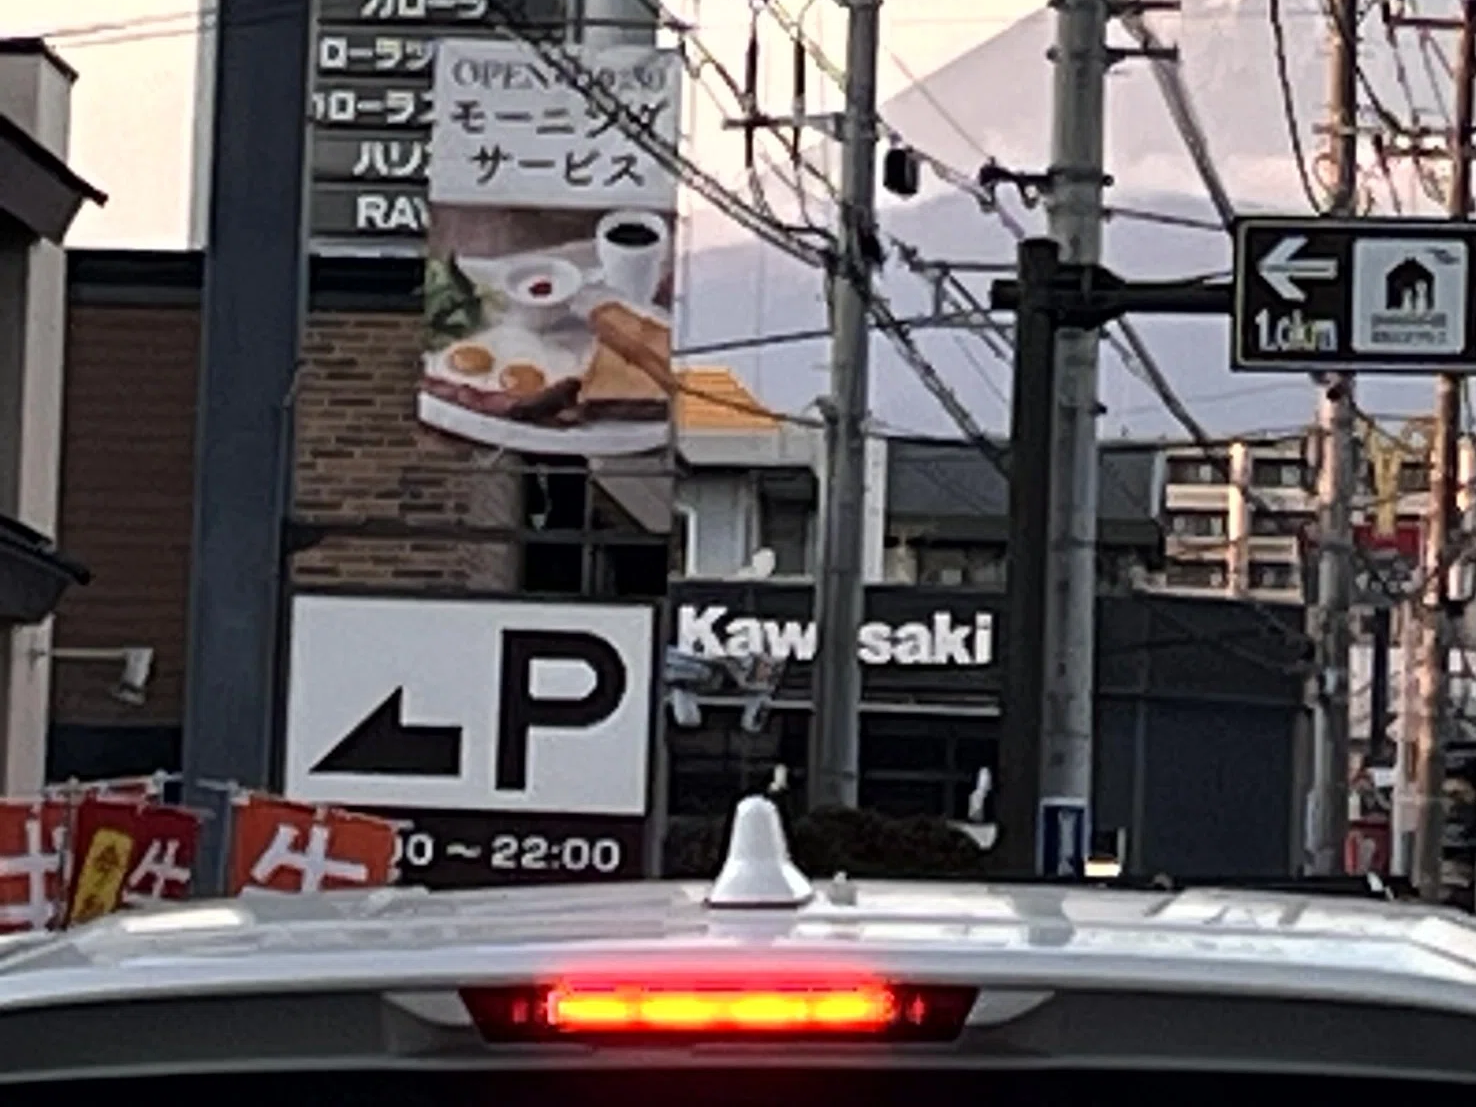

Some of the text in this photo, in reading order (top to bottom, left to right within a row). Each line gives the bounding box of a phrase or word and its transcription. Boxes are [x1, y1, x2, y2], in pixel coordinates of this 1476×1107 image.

[352, 140, 434, 177] ハリ
[470, 143, 645, 189] サービス
[677, 604, 994, 666] Kawsaki
[496, 629, 628, 792] P
